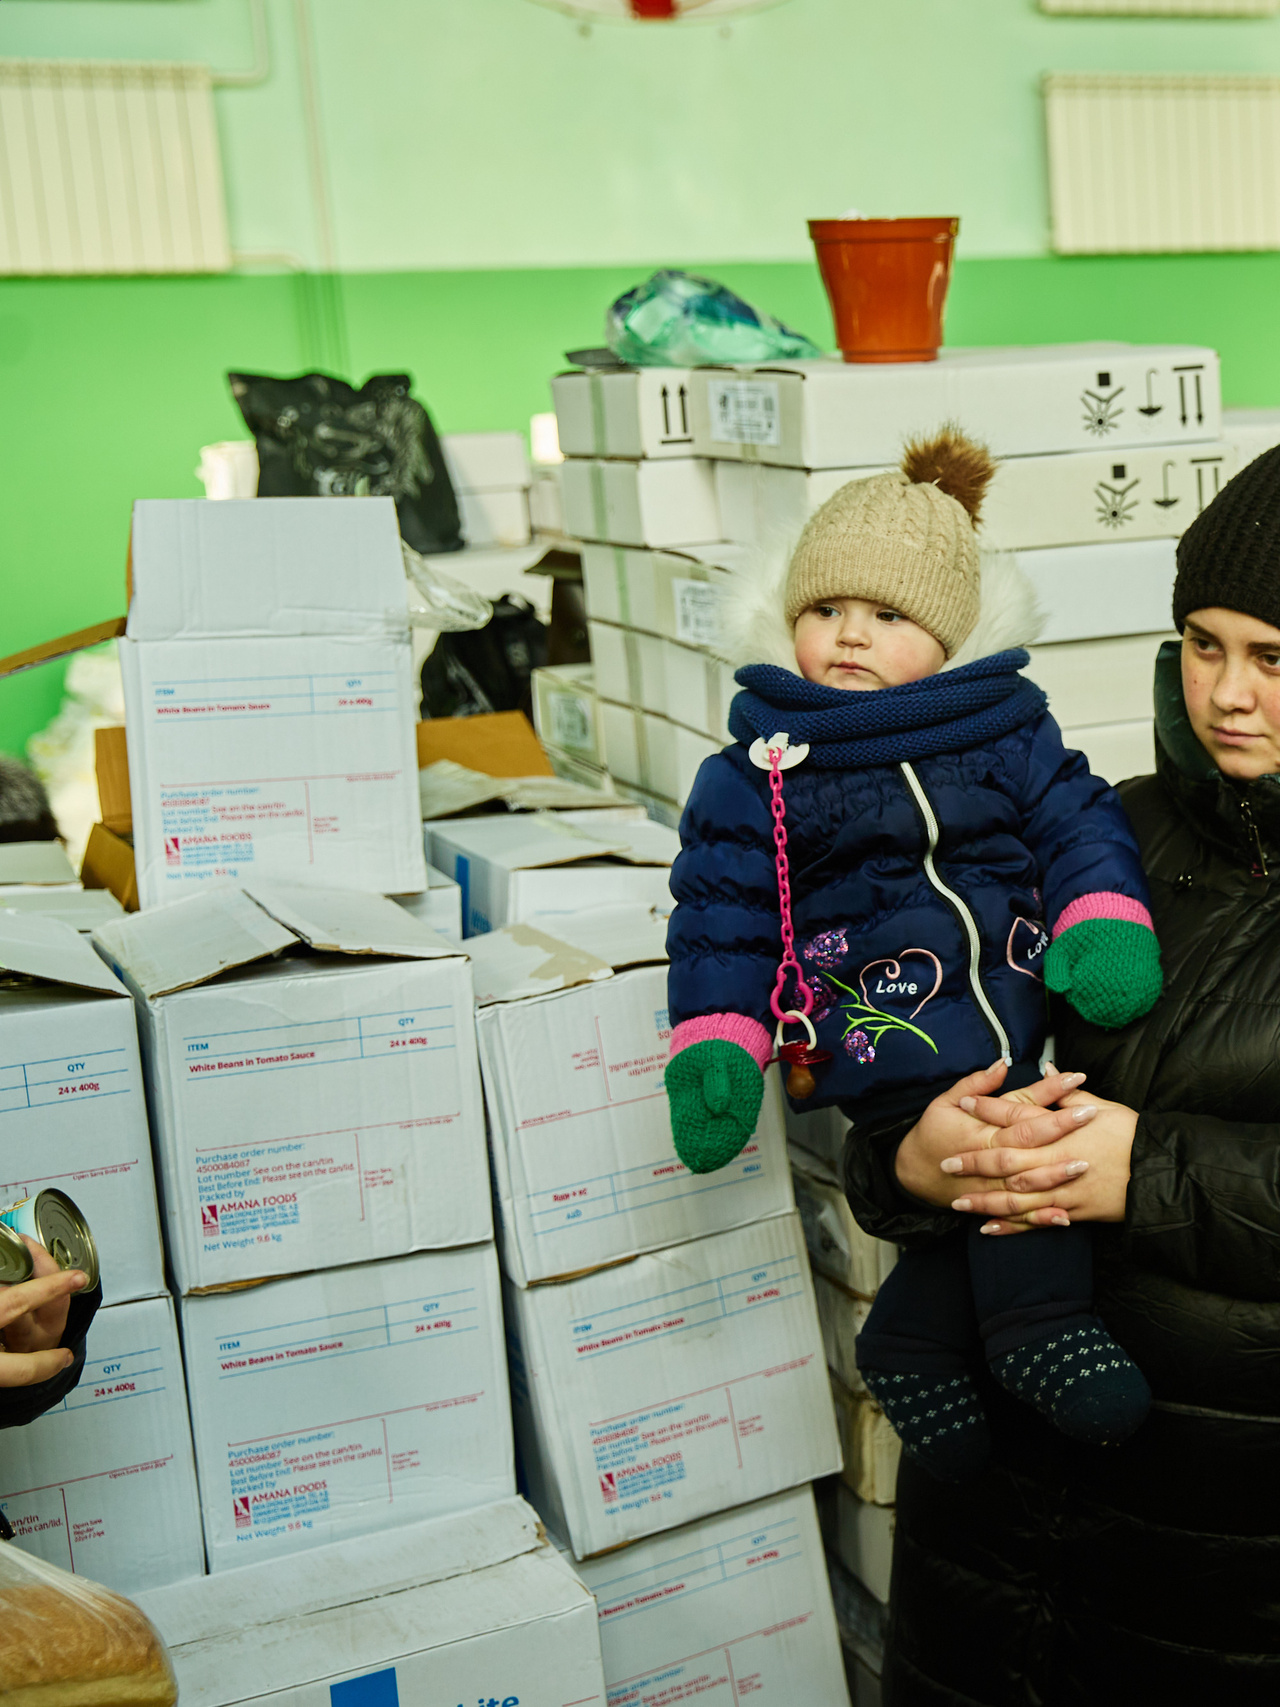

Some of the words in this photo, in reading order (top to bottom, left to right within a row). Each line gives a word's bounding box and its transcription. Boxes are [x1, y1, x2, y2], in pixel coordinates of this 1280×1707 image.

[875, 980, 918, 995] Love
[187, 1043, 209, 1052] ITEM
[67, 1062, 85, 1073] QTY
[189, 1062, 216, 1073] White
[217, 1060, 244, 1070] Beans
[245, 1058, 254, 1067] in
[255, 1054, 289, 1065] Tomato
[290, 1051, 315, 1060] Sauce
[58, 1086, 70, 1096] 24
[79, 1082, 100, 1092] 400g
[195, 1151, 238, 1165] Purchase
[240, 1148, 265, 1159] order
[197, 1174, 212, 1184] Lot
[252, 1167, 269, 1176] See
[271, 1165, 284, 1173] on
[285, 1161, 301, 1170] the
[199, 1191, 232, 1203] Packed
[233, 1189, 246, 1200] by
[219, 1199, 261, 1213] AMANA
[262, 1192, 297, 1207] FOODS
[204, 1244, 220, 1252] Net
[222, 1237, 255, 1249] Weight
[271, 1233, 282, 1242] kg
[219, 1341, 240, 1351] ITEM
[220, 1360, 247, 1371] White
[248, 1355, 274, 1366] Beans
[275, 1352, 284, 1360] in
[285, 1346, 318, 1359] Tomato
[318, 1341, 343, 1352] Sauce
[103, 1363, 121, 1374] QTY
[94, 1388, 105, 1397] 24
[114, 1382, 136, 1392] 400g
[228, 1445, 270, 1459] Purchase
[271, 1439, 296, 1450] order
[251, 1489, 291, 1504] AMANA
[293, 1480, 327, 1495] FOODS
[11, 1514, 39, 1528] an/tin
[19, 1526, 33, 1536] the
